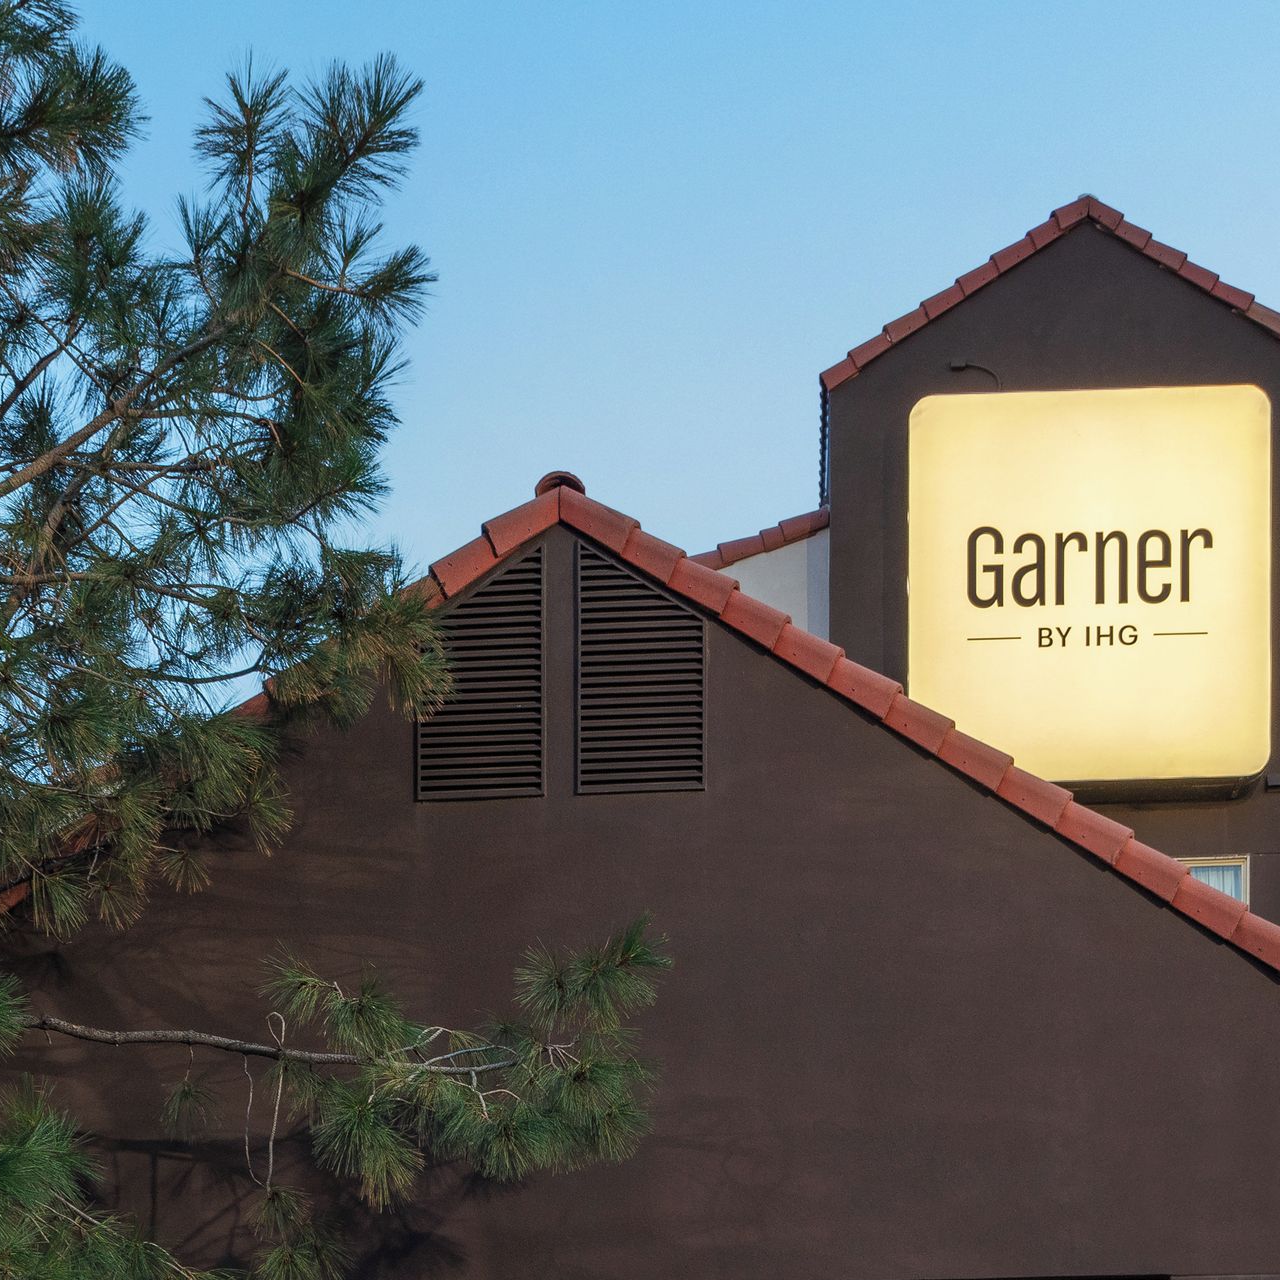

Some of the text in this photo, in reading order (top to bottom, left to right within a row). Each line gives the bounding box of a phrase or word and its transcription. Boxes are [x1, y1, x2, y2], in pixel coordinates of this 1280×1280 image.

[967, 526, 1213, 608] Garner
[1038, 625, 1138, 648] BY IHG
